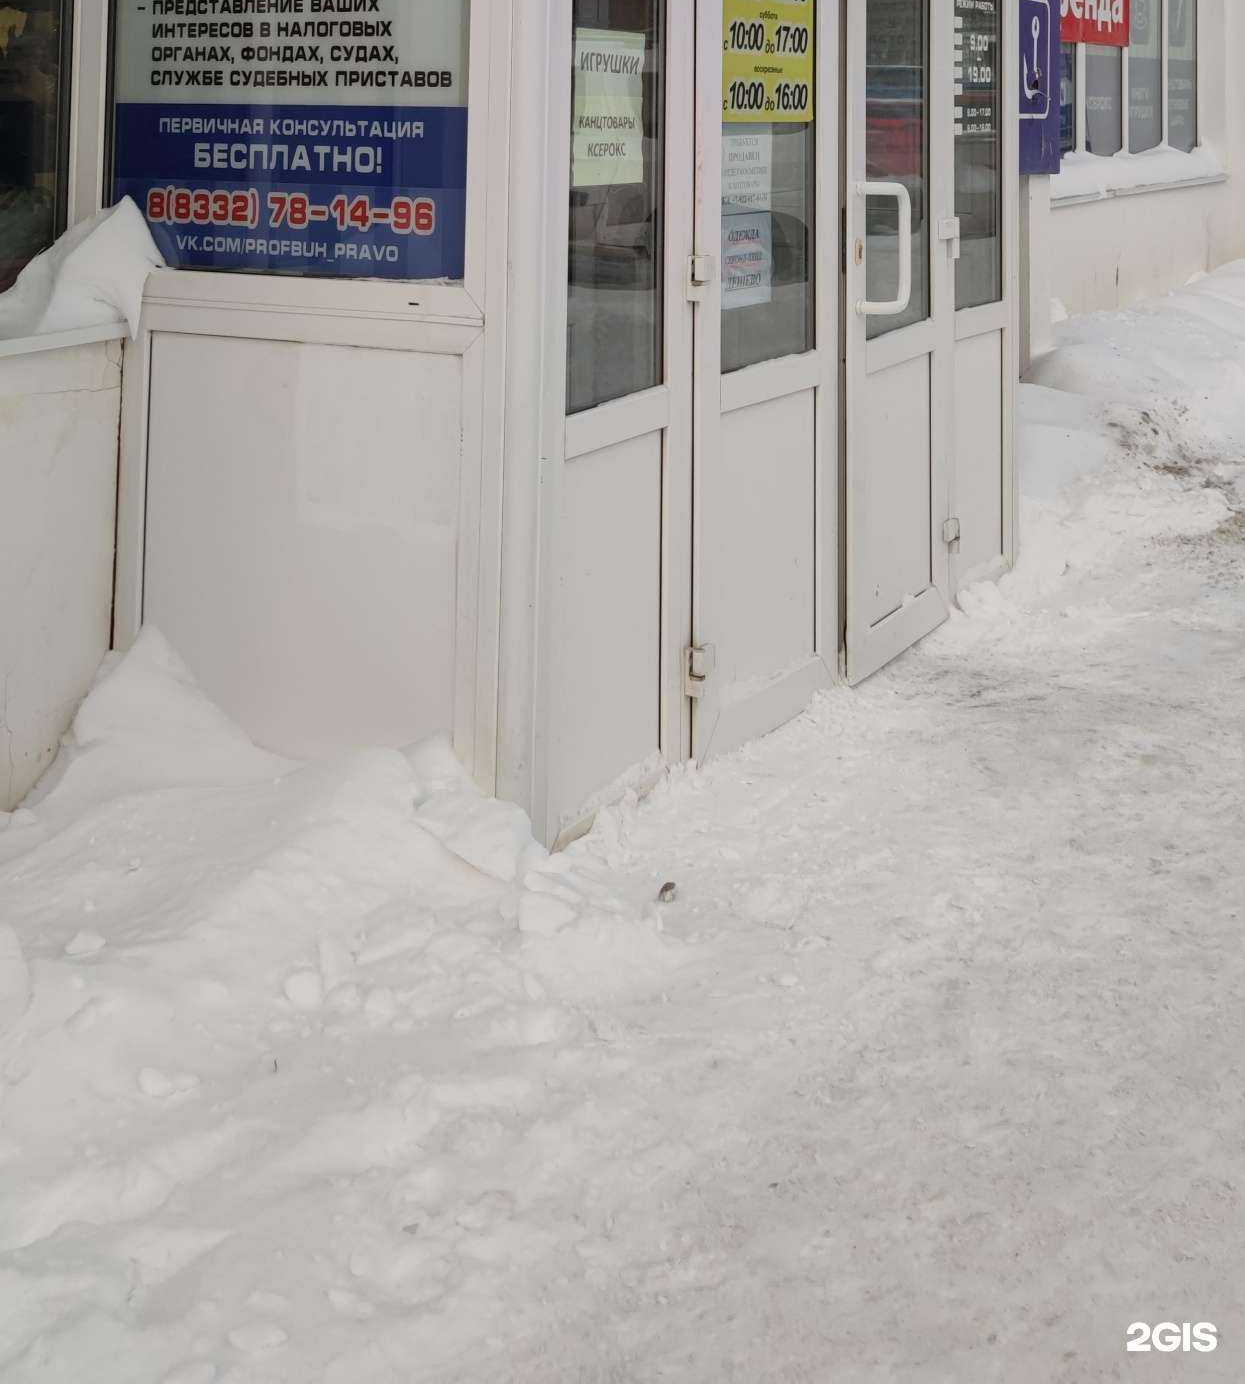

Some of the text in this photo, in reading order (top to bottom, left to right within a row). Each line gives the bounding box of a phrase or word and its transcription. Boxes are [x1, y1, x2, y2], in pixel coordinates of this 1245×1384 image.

[152, 21, 392, 38] ИНТЕРЕСОВ В НАЛОГОВЫХ
[729, 20, 764, 51] 10:00
[765, 37, 775, 53] до
[775, 24, 808, 54] 17:00
[969, 34, 989, 52] 9.00
[151, 45, 399, 64] ОРГАНАХ, ФОНДАХ, СУДАХ,
[580, 51, 640, 75] ИГРУШКИ
[150, 70, 453, 88] СЛУЖБЕ СУДЕБНЫХ ПРИСТАВОВ
[967, 66, 992, 83] 19.00
[729, 81, 765, 110] 10:00
[765, 95, 775, 110] до
[775, 81, 808, 111] 16:00
[159, 118, 424, 141] ПЕРВИЧНАЯ КОНСУЛЬТАЦИЯ
[579, 115, 636, 132] КАНЦТОВАРЫ
[194, 142, 383, 174] БЕСПЛАТНО!
[587, 142, 627, 157] КСЕРОКС
[147, 186, 436, 236] 8(8332) 78-14-96
[176, 234, 399, 263] VK.COM/PROFBUH_PRAVO
